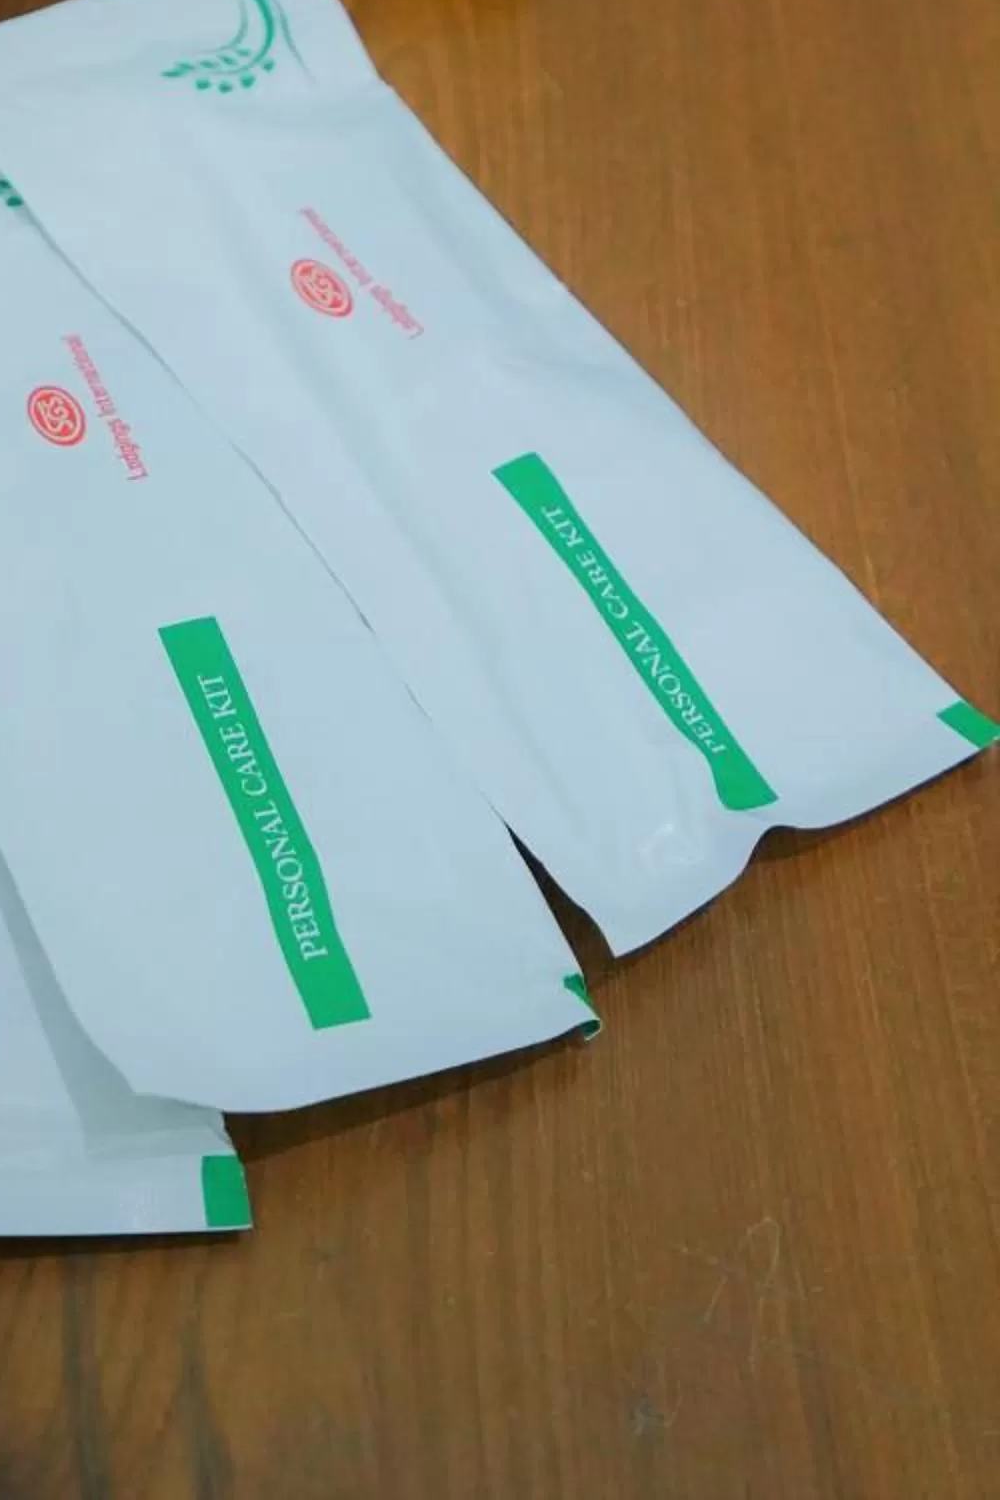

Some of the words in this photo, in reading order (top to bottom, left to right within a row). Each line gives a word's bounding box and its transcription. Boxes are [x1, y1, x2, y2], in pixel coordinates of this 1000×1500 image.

[540, 504, 585, 548] KIT
[576, 550, 629, 620] CARE
[197, 674, 237, 720] KIT
[625, 621, 727, 755] PERSONAL
[219, 722, 268, 796] CARE
[254, 801, 328, 961] PERSONAL
